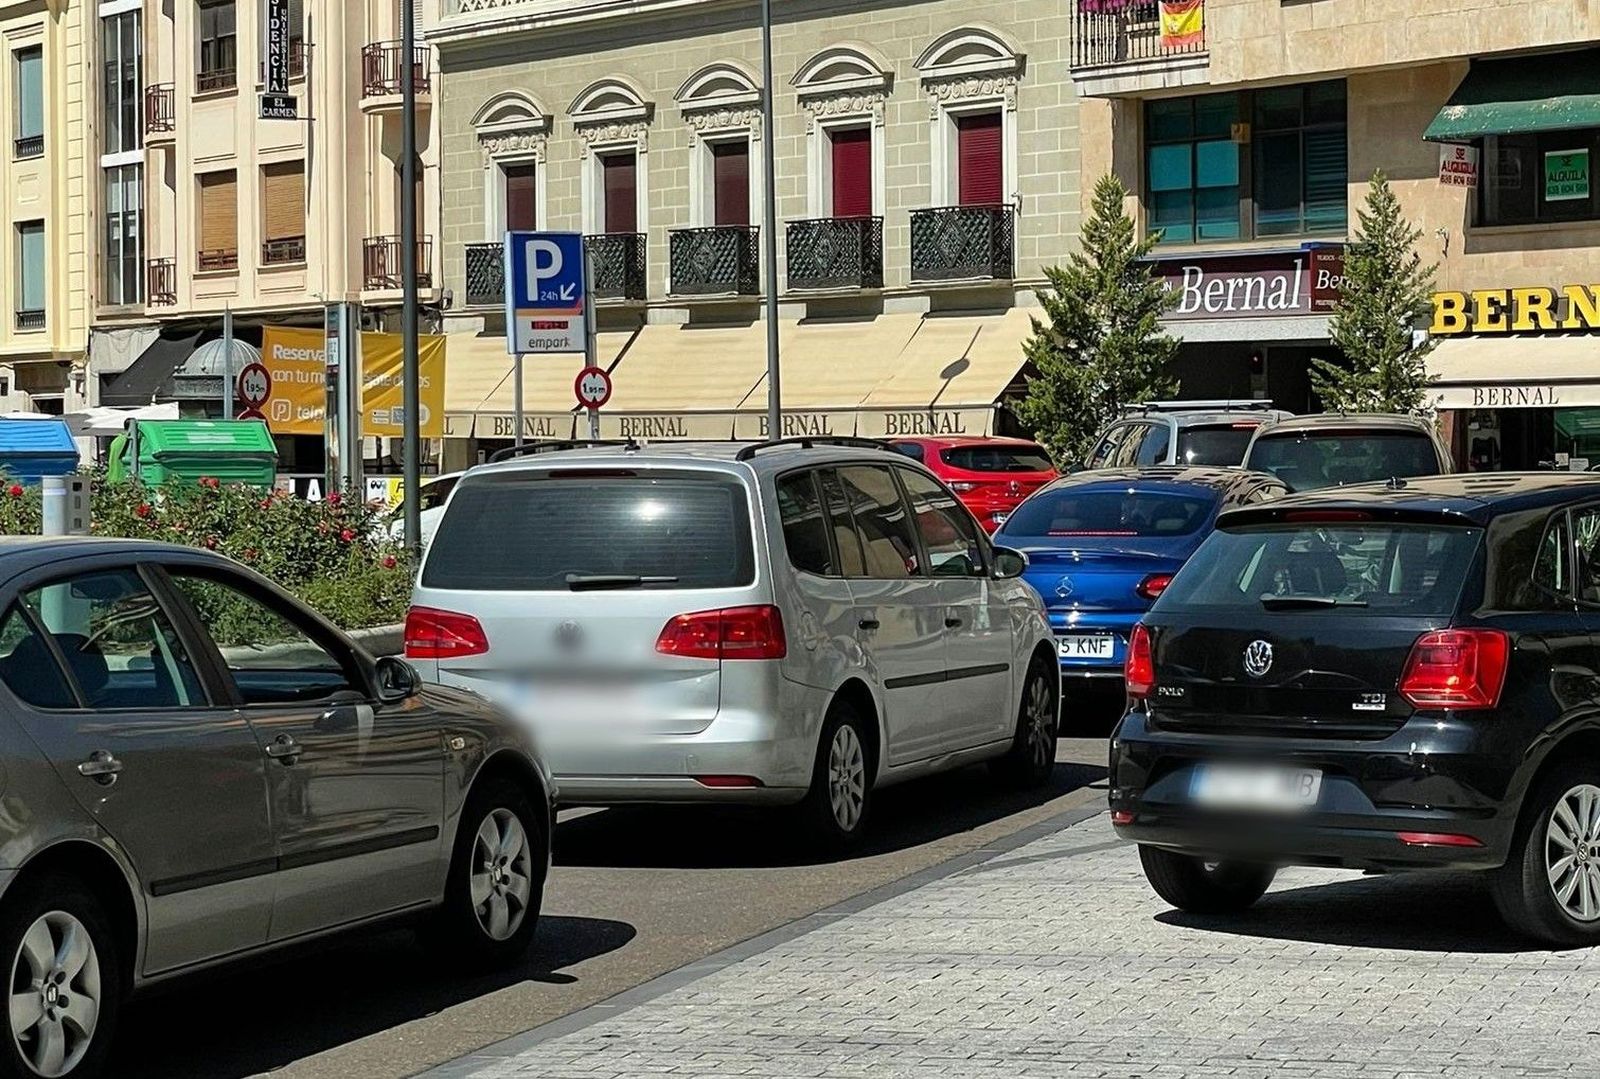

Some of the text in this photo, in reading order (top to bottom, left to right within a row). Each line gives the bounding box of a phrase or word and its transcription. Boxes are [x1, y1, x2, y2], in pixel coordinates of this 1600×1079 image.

[274, 98, 286, 107] EL
[263, 107, 297, 117] CARMEN
[1549, 169, 1587, 181] ALQUILA
[525, 240, 563, 302] P
[541, 290, 558, 301] 24h
[1177, 259, 1303, 314] Bernal
[1429, 285, 1600, 334] BERN
[528, 336, 571, 350] empark
[272, 343, 326, 362] Reserva
[271, 370, 293, 382] con
[296, 370, 309, 384] tu
[1473, 387, 1560, 406] BERNAL
[493, 417, 556, 437] BENAL
[619, 417, 688, 437] BERNAL
[758, 414, 833, 437] BRNAL
[884, 411, 966, 435] BERNAL
[1076, 637, 1110, 654] KNF
[1158, 686, 1185, 696] POLO
[1361, 693, 1386, 703] TDI
